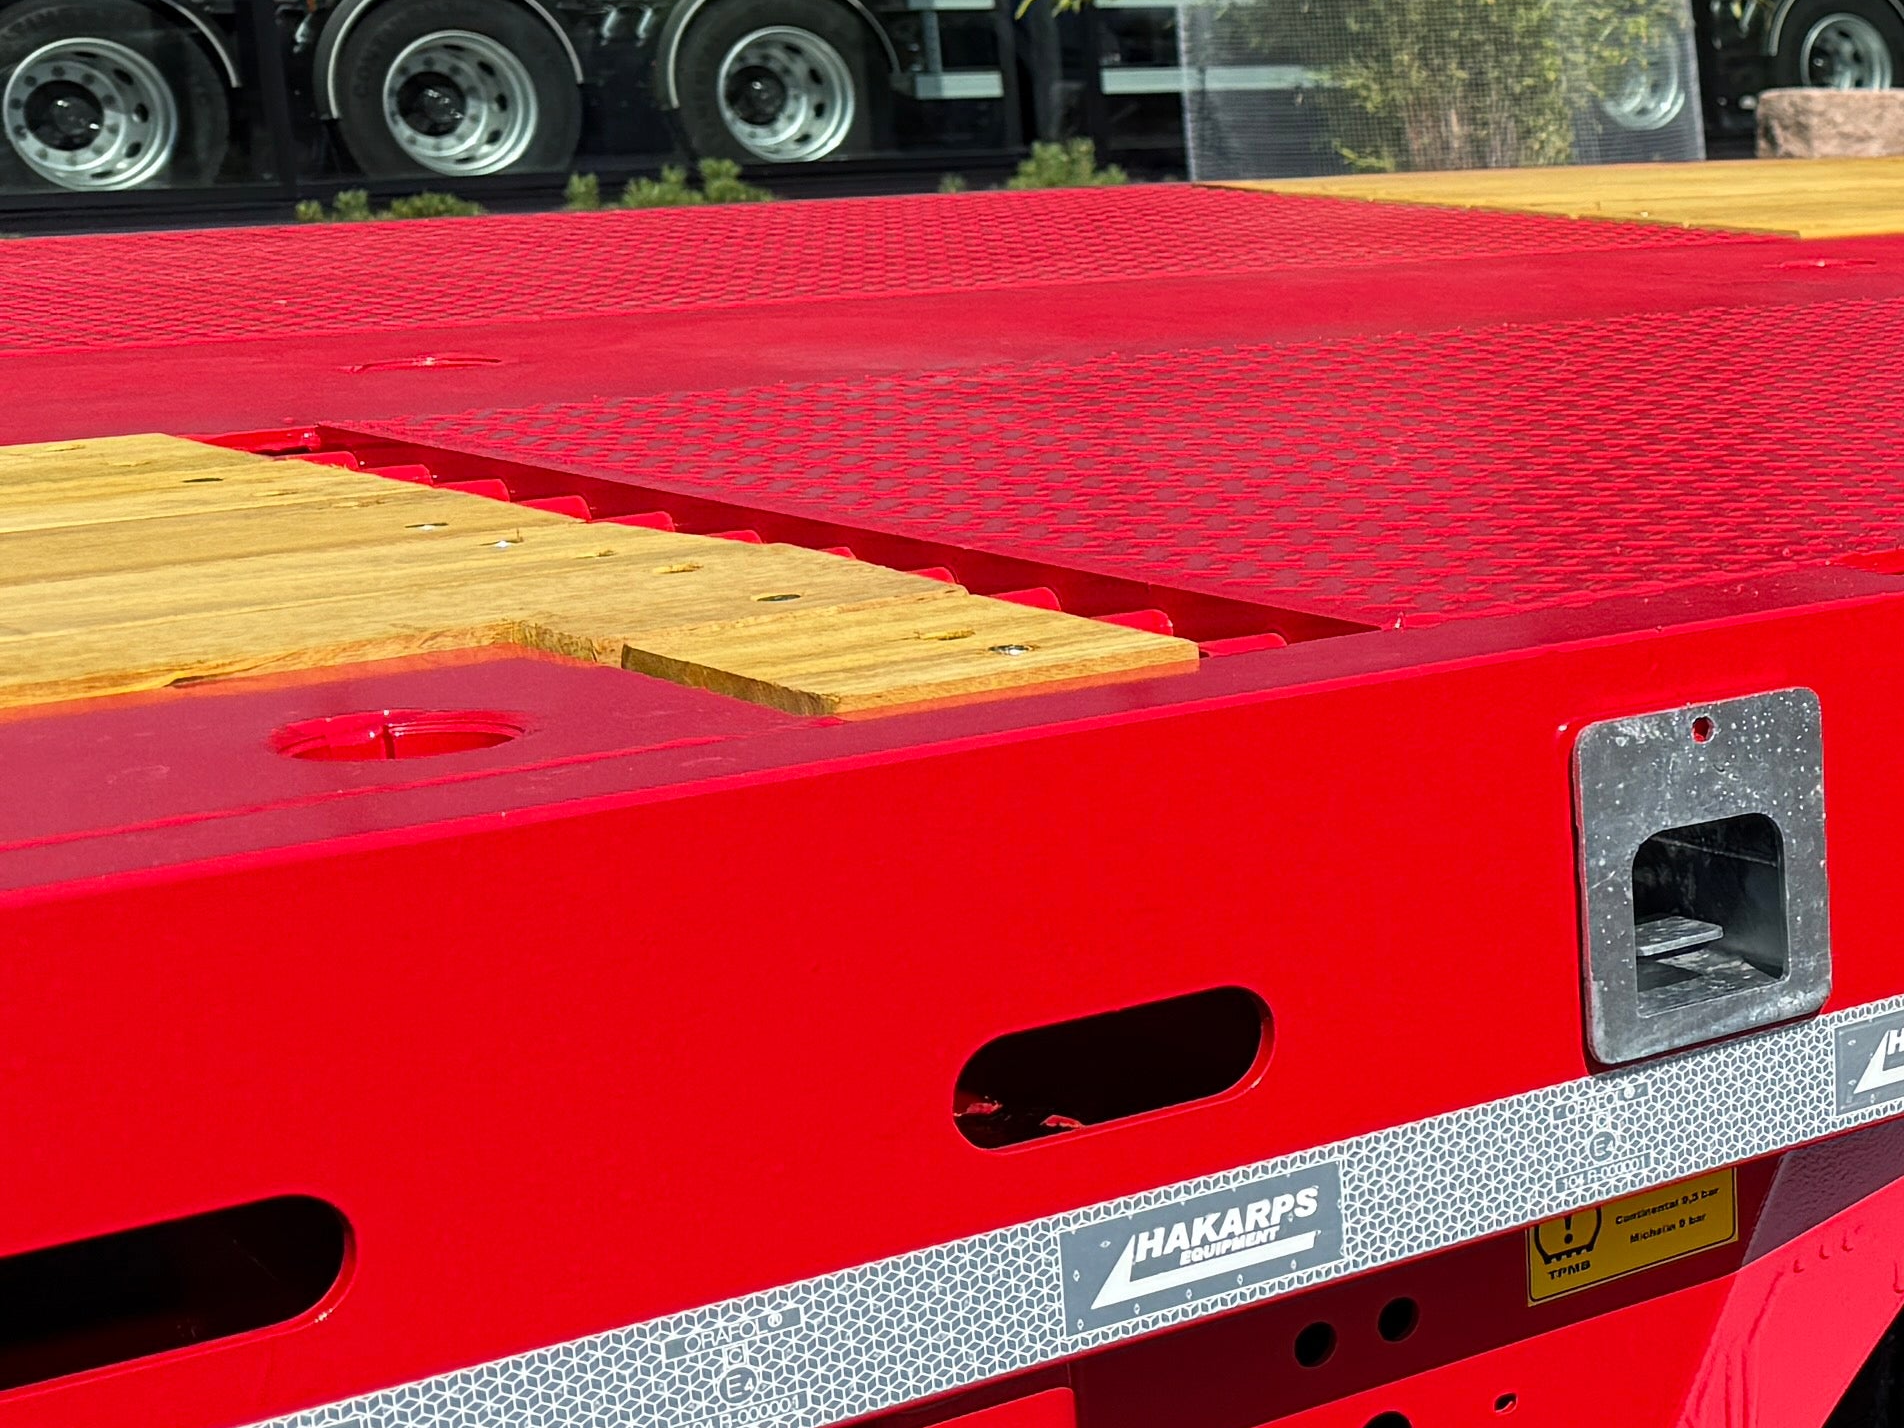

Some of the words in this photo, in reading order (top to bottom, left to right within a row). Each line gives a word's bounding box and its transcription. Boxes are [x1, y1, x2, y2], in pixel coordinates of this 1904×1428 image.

[1136, 1187, 1320, 1263] HAKARPS
[1615, 1198, 1679, 1226] Continental
[1701, 1185, 1721, 1199] bar
[1179, 1225, 1281, 1266] EQUIPMENT
[1629, 1222, 1677, 1245] Michelin
[1688, 1213, 1708, 1227] bar
